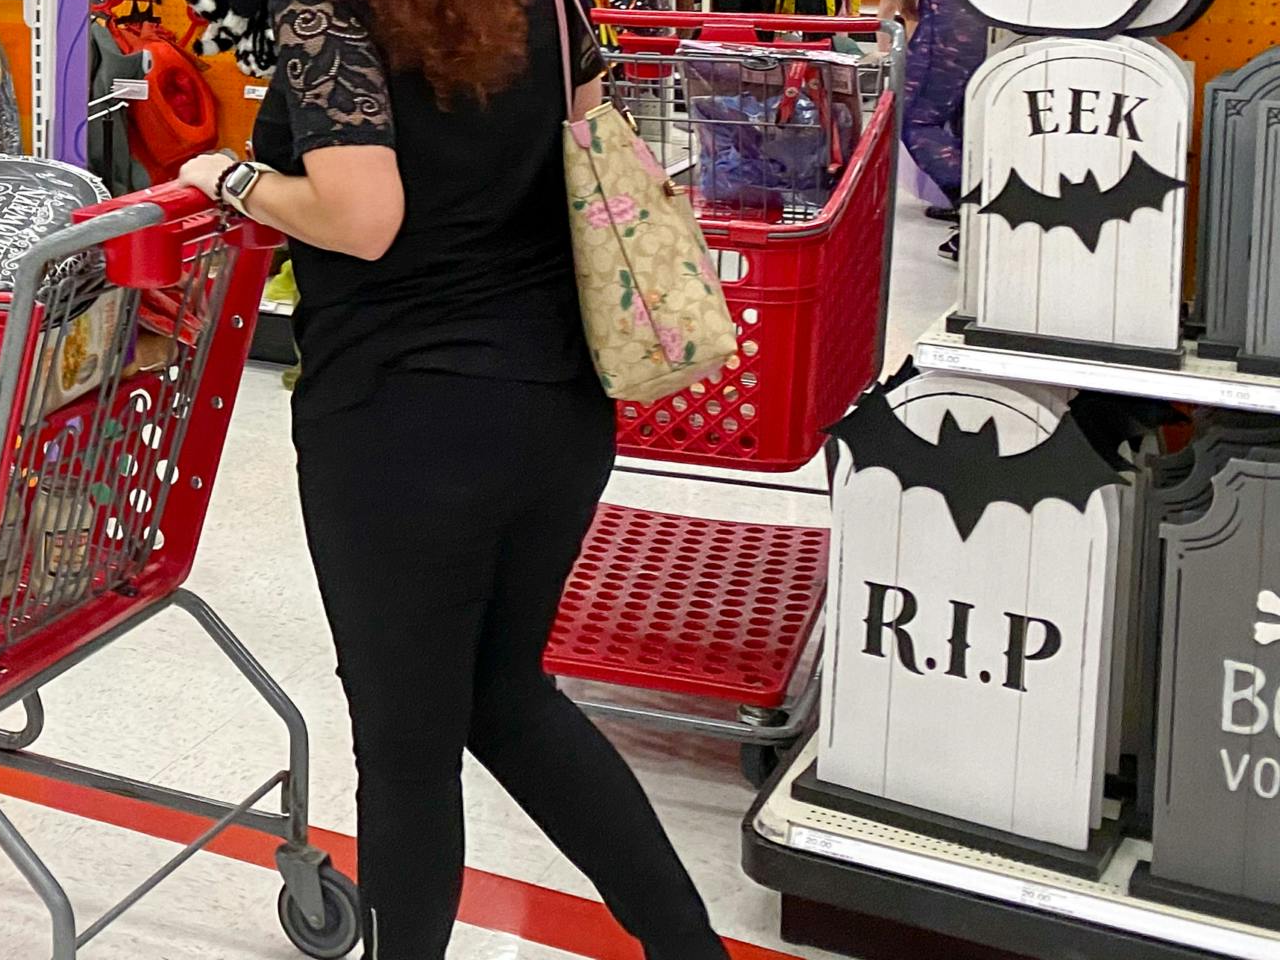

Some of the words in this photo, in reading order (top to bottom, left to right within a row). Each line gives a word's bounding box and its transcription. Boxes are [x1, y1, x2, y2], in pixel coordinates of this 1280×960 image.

[1022, 87, 1149, 142] EEK
[861, 580, 1062, 693] R.I.P
[1221, 659, 1280, 738] B
